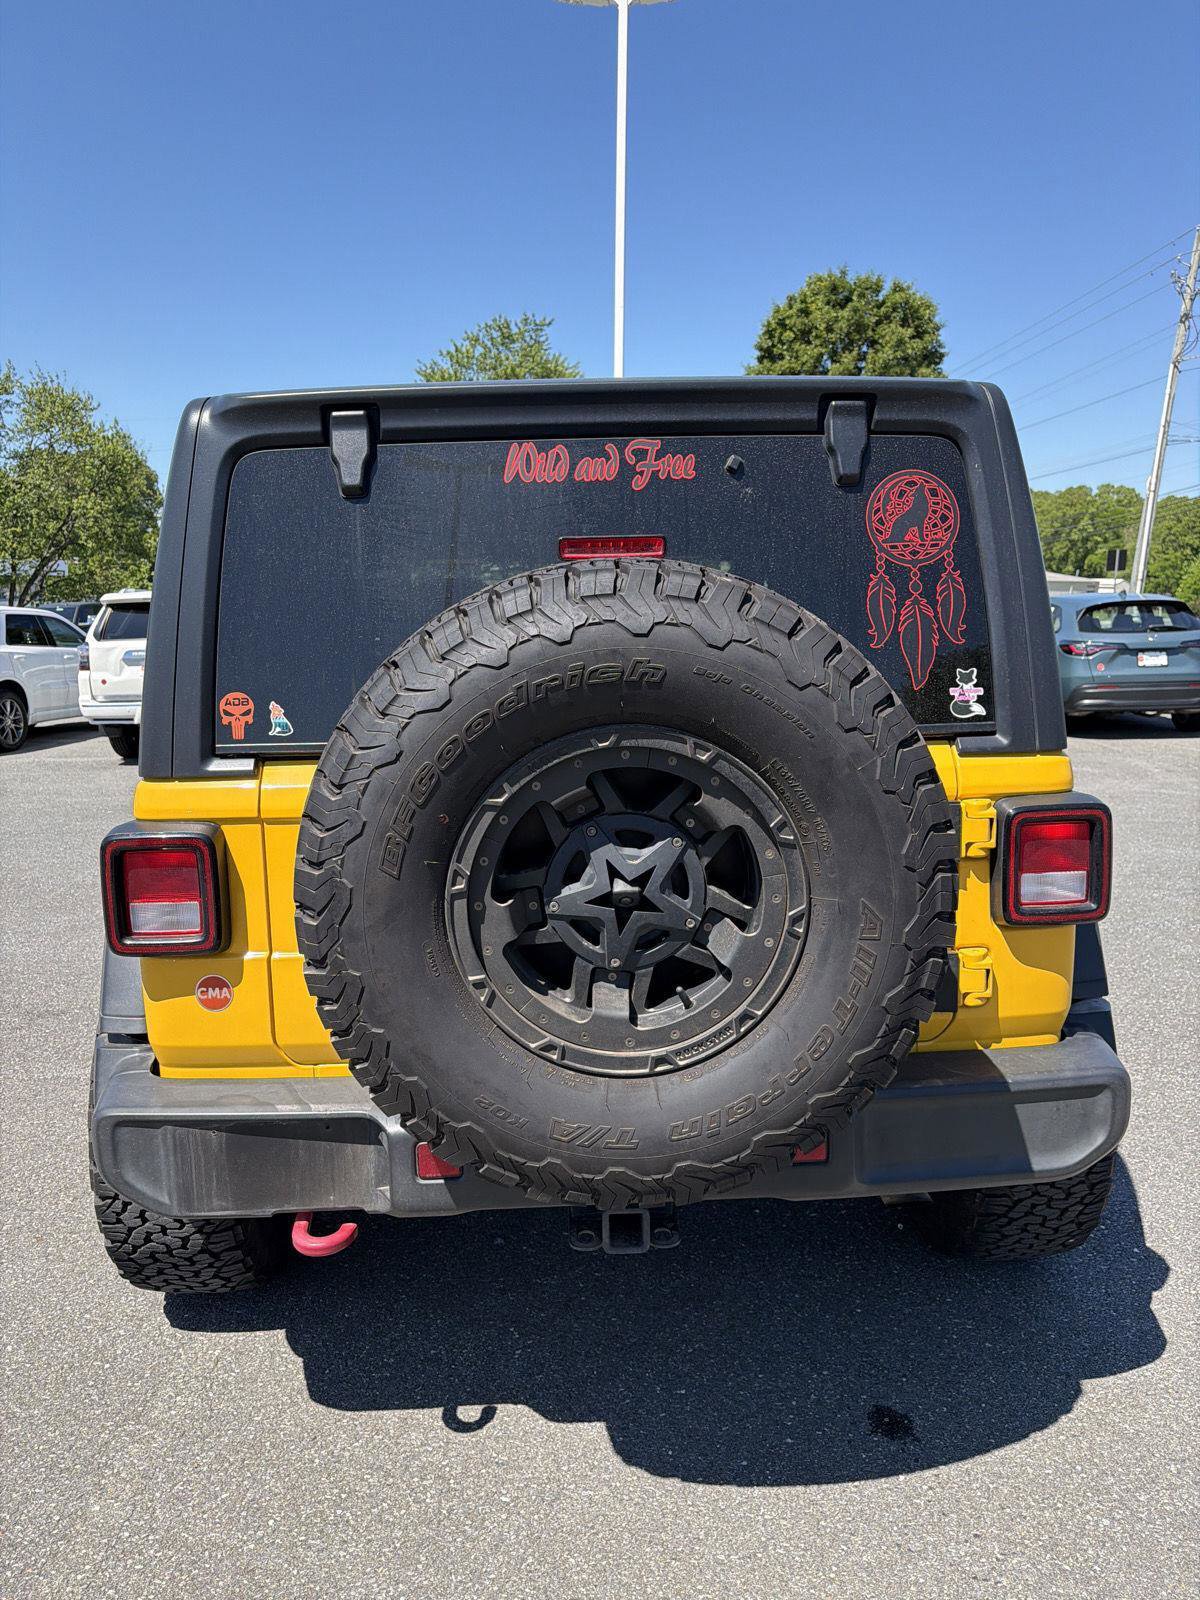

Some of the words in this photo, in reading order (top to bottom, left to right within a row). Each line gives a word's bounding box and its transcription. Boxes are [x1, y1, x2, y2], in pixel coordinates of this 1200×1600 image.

[503, 441, 570, 484] Wild
[574, 443, 620, 482] and
[625, 438, 696, 491] Free
[224, 697, 250, 707] ADB
[740, 683, 816, 740] Champion
[378, 656, 666, 881] BFGoodrich
[197, 987, 231, 999] CMA
[668, 897, 884, 1142] All-Terrain
[674, 1025, 735, 1061] ROCKSTAR
[550, 1116, 640, 1150] T/A
